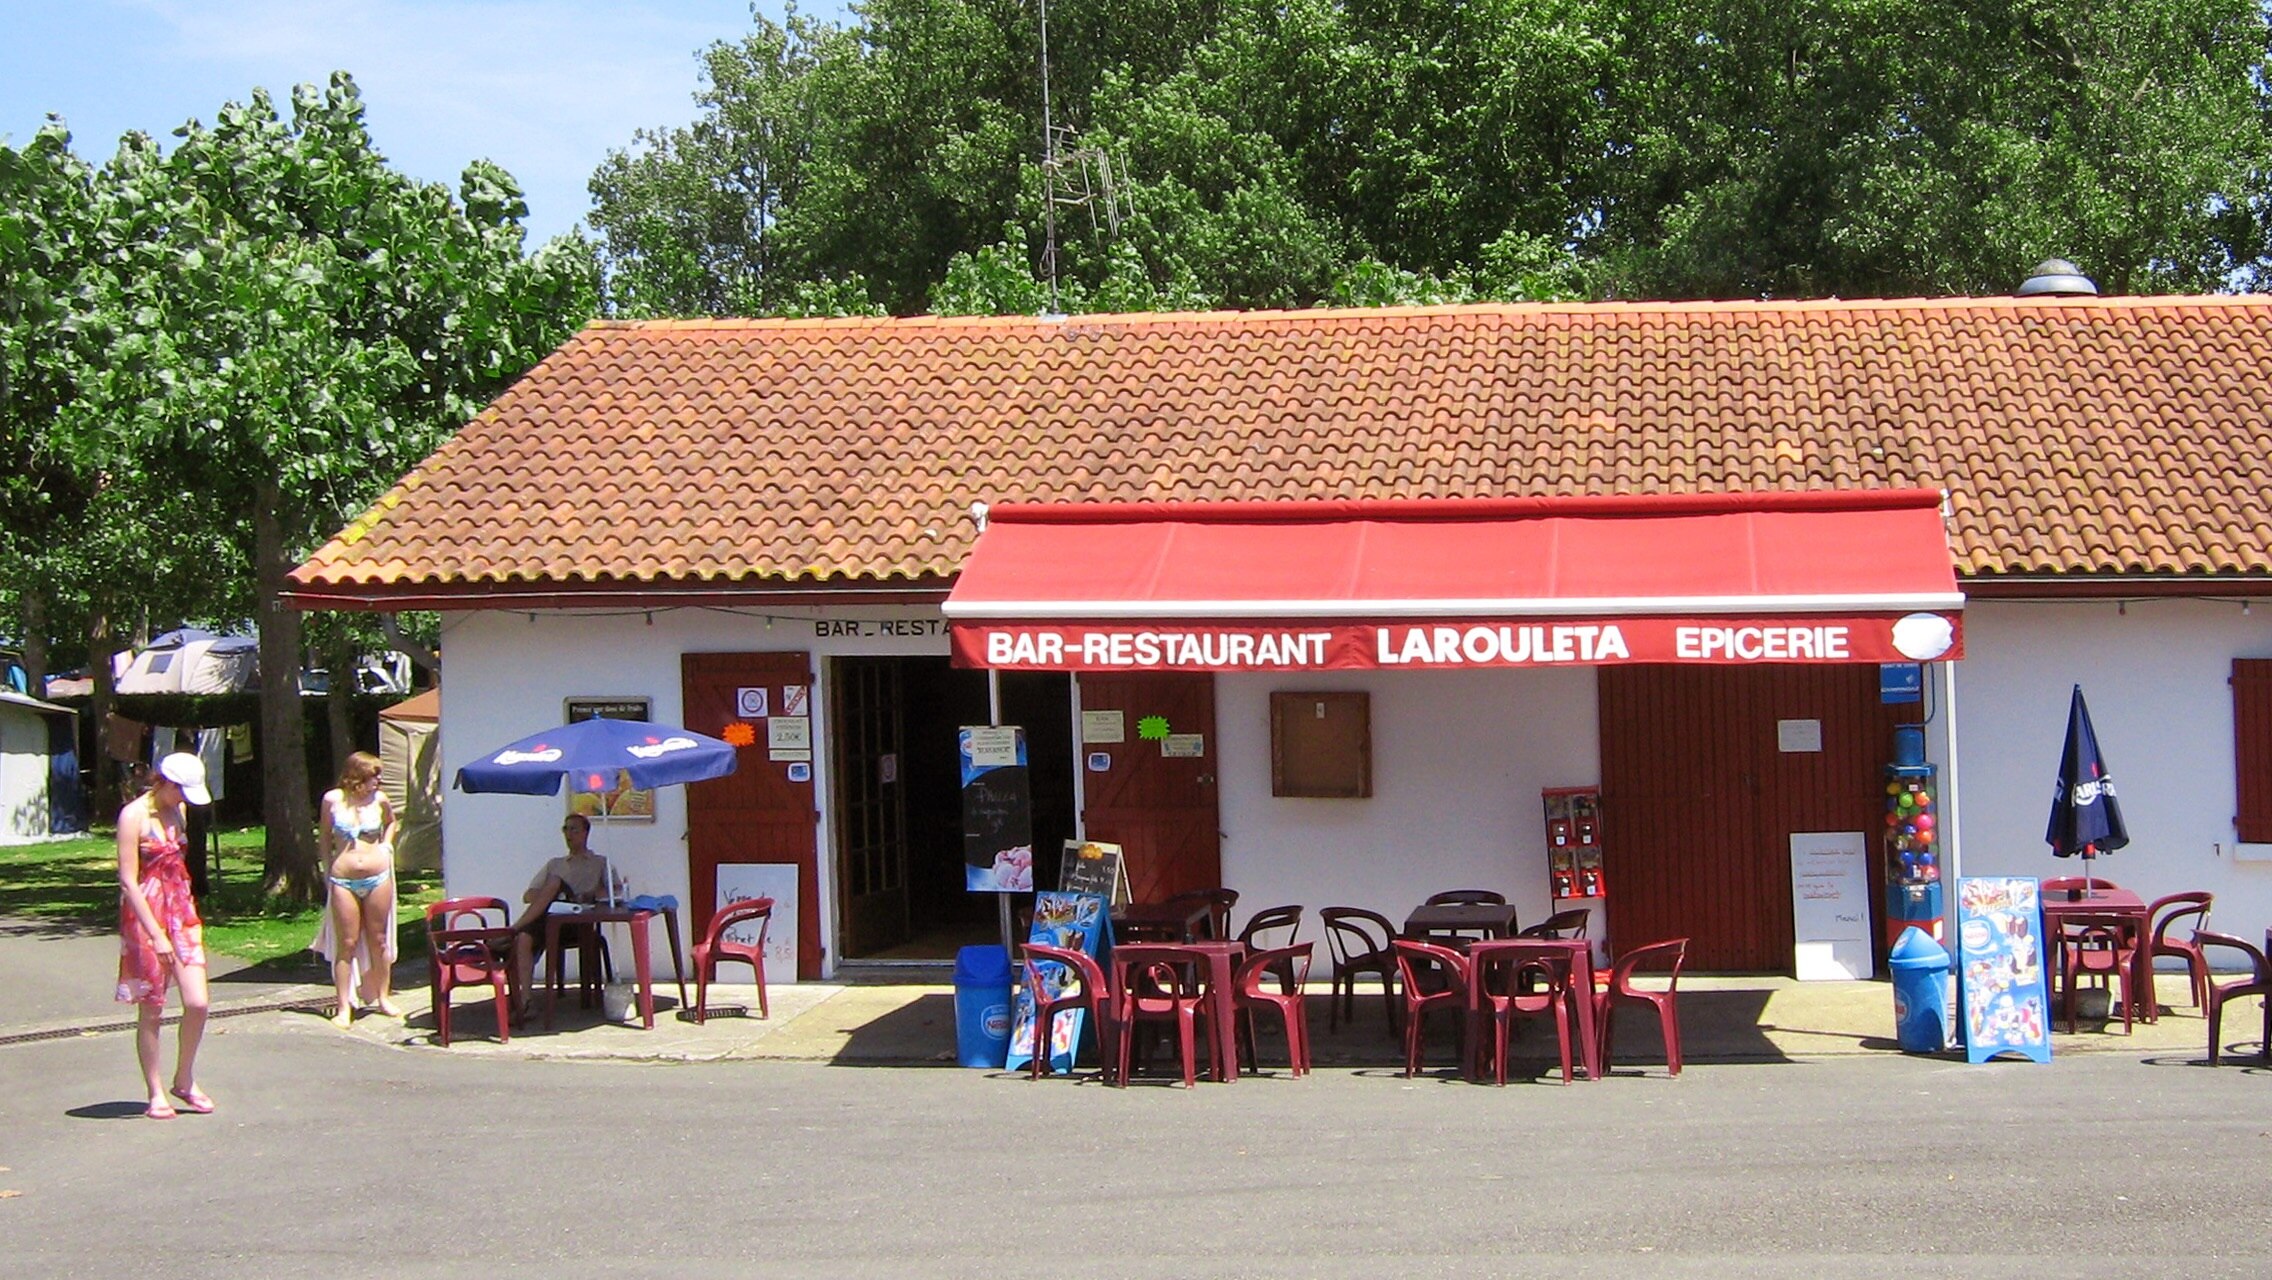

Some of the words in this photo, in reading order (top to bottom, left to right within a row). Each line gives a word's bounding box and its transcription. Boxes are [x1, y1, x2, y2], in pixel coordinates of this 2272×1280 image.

[816, 621, 859, 637] BAR
[1376, 625, 1629, 663] LAROULETA
[1676, 627, 1849, 659] EPICERIE
[987, 632, 1332, 666] BAR-RESTAURANT
